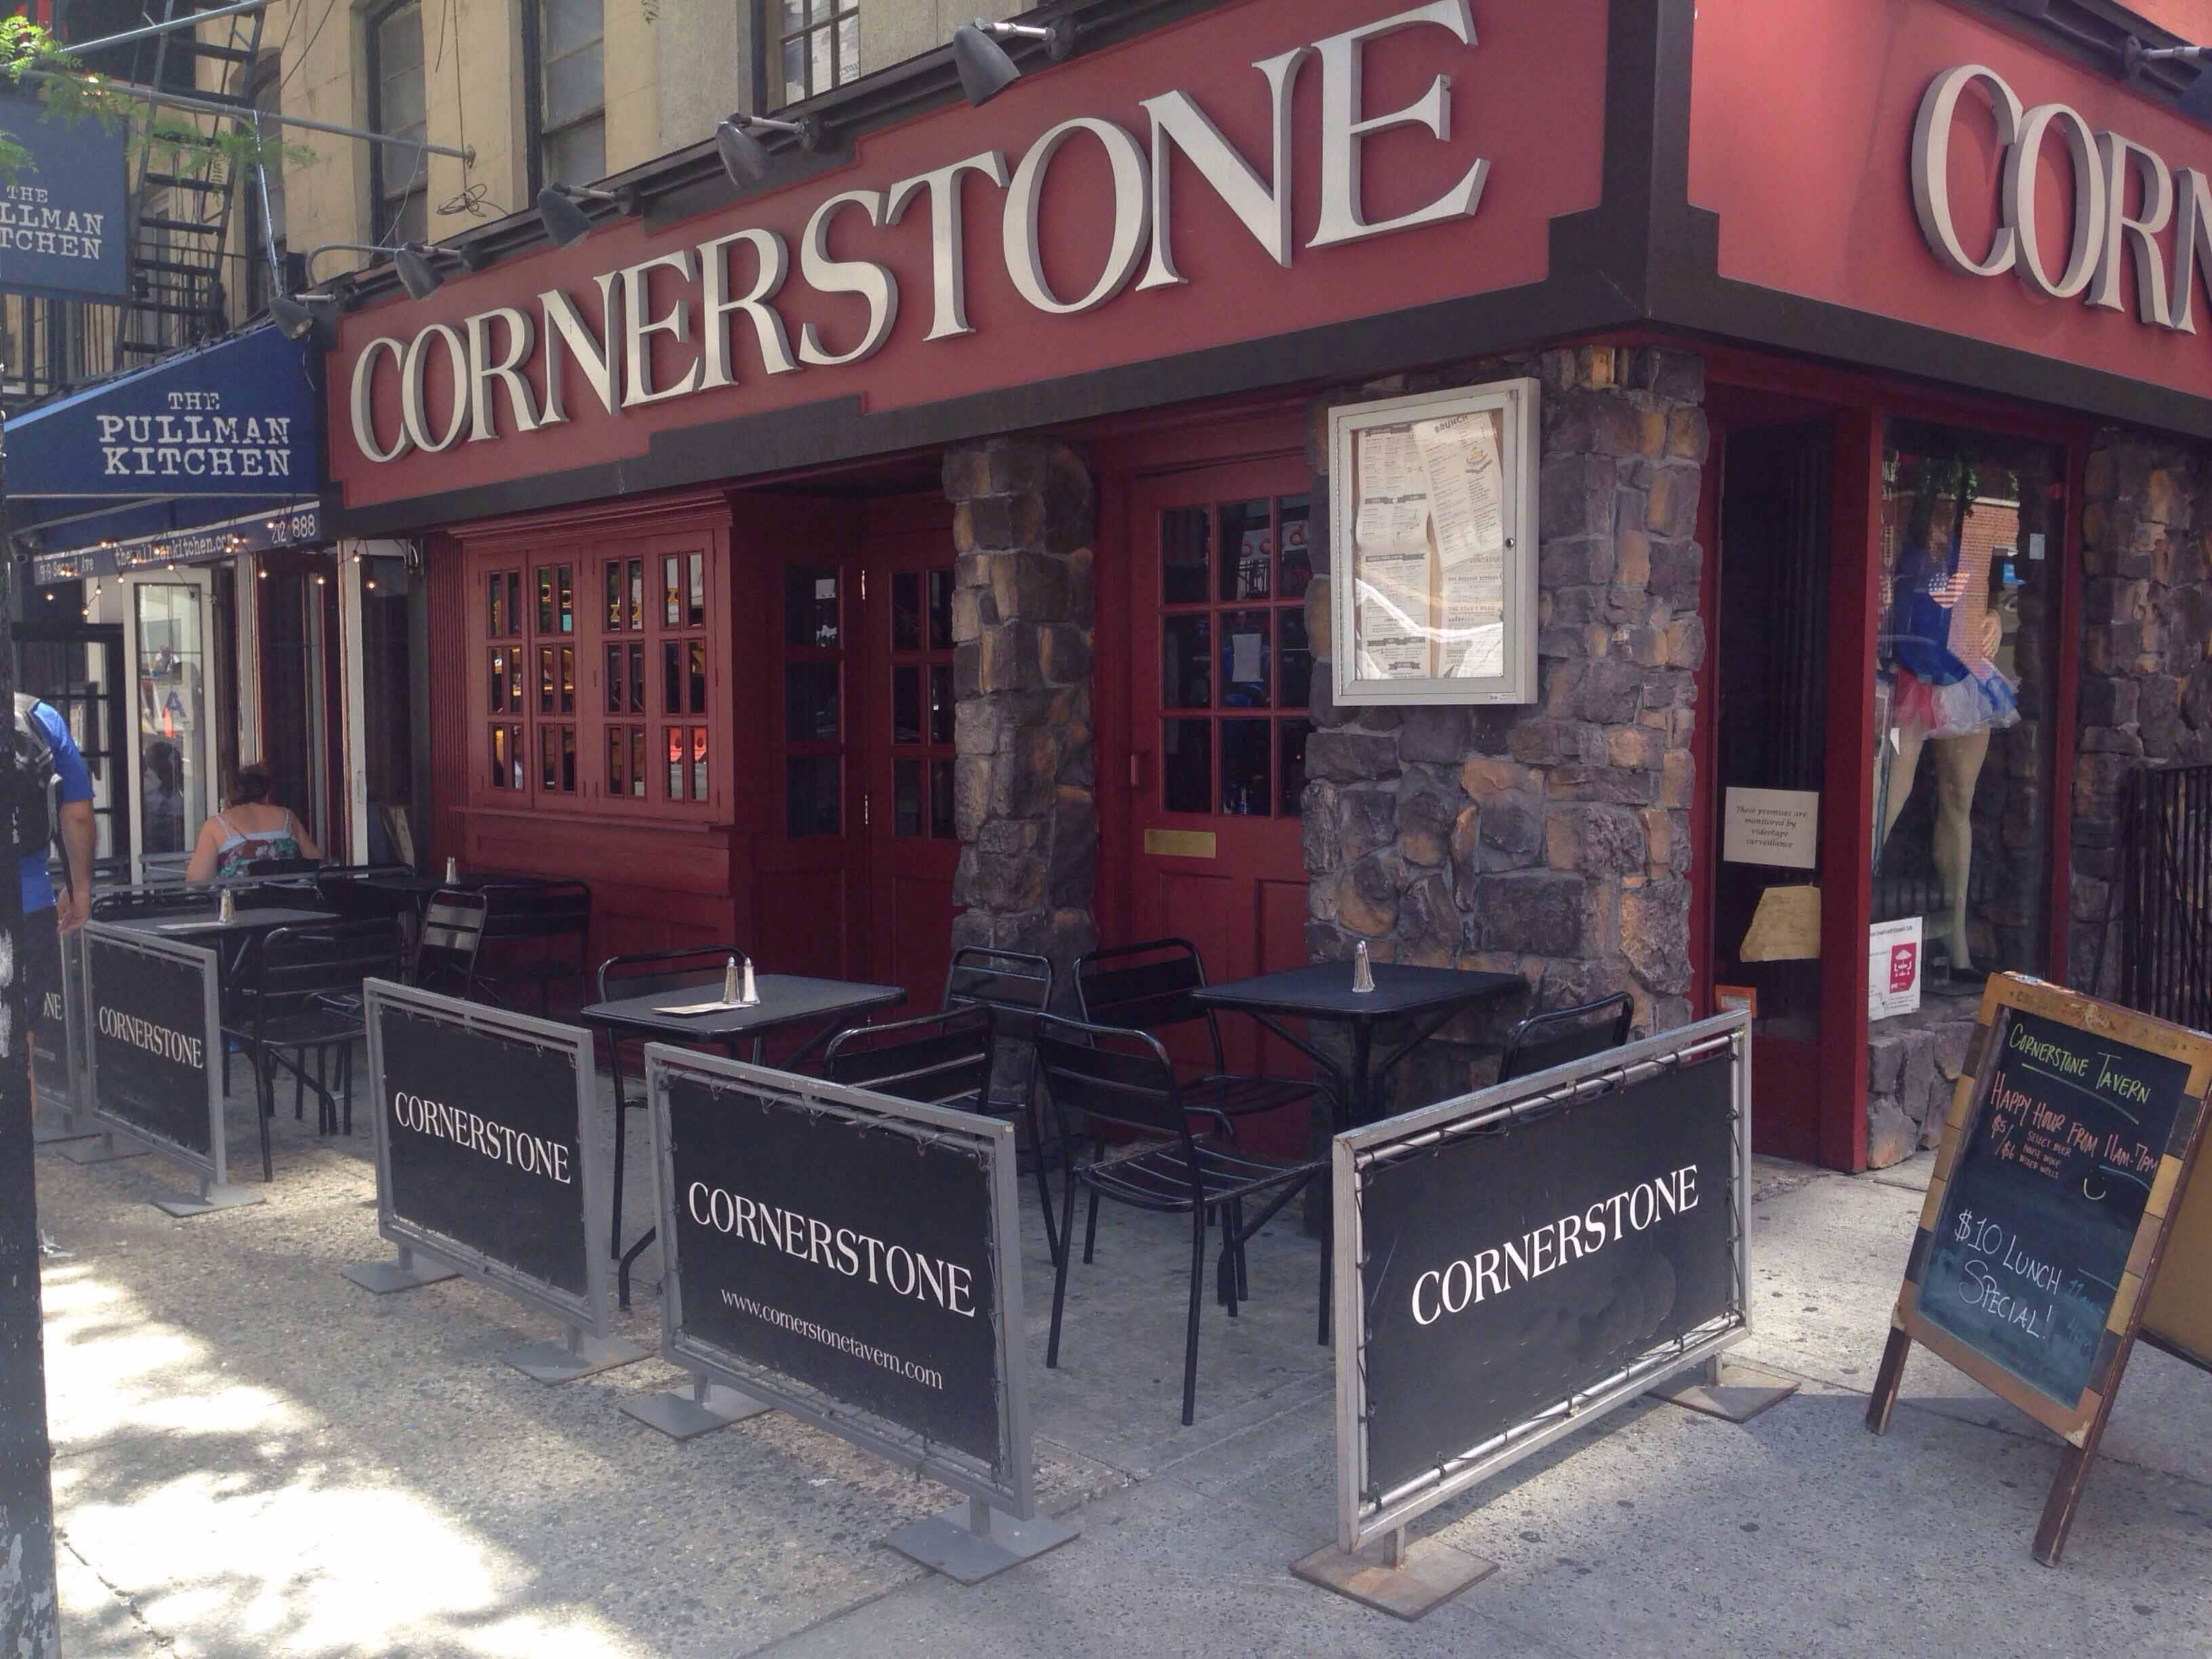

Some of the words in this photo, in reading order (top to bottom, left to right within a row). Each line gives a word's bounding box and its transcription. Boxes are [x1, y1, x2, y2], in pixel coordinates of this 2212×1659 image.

[7, 185, 48, 203] THE
[351, 0, 1488, 464] CORNERSTONE
[168, 392, 220, 410] THE
[97, 415, 290, 445] PULLMAN
[1434, 414, 1468, 434] BRUNCH
[103, 447, 290, 476] KITCHEN
[292, 514, 315, 538] 888
[1745, 818, 1784, 827] monitored
[1786, 819, 1797, 830] by
[1757, 808, 1791, 817] premises
[1751, 828, 1788, 838] videotape
[43, 992, 62, 1021] NE
[99, 1006, 203, 1069] CORNERSTONE
[2009, 1023, 2089, 1077] CORNERSTONE
[2096, 1052, 2151, 1104] TAVERN
[1990, 1071, 2032, 1126] HAPPY
[2032, 1102, 2066, 1132] HOUR
[2066, 1122, 2098, 1158] FROM
[395, 1092, 571, 1185] CORNERSTONE
[2028, 1130, 2051, 1148] SELECT
[2043, 1154, 2061, 1168] WINE
[689, 1182, 975, 1317] CORNERSTONE
[1412, 1164, 1699, 1325] CORNERSTONE
[1954, 1209, 2002, 1254] $10
[2003, 1234, 2062, 1296] LUNCH
[721, 1289, 943, 1389] www.cornerstonetavern.com
